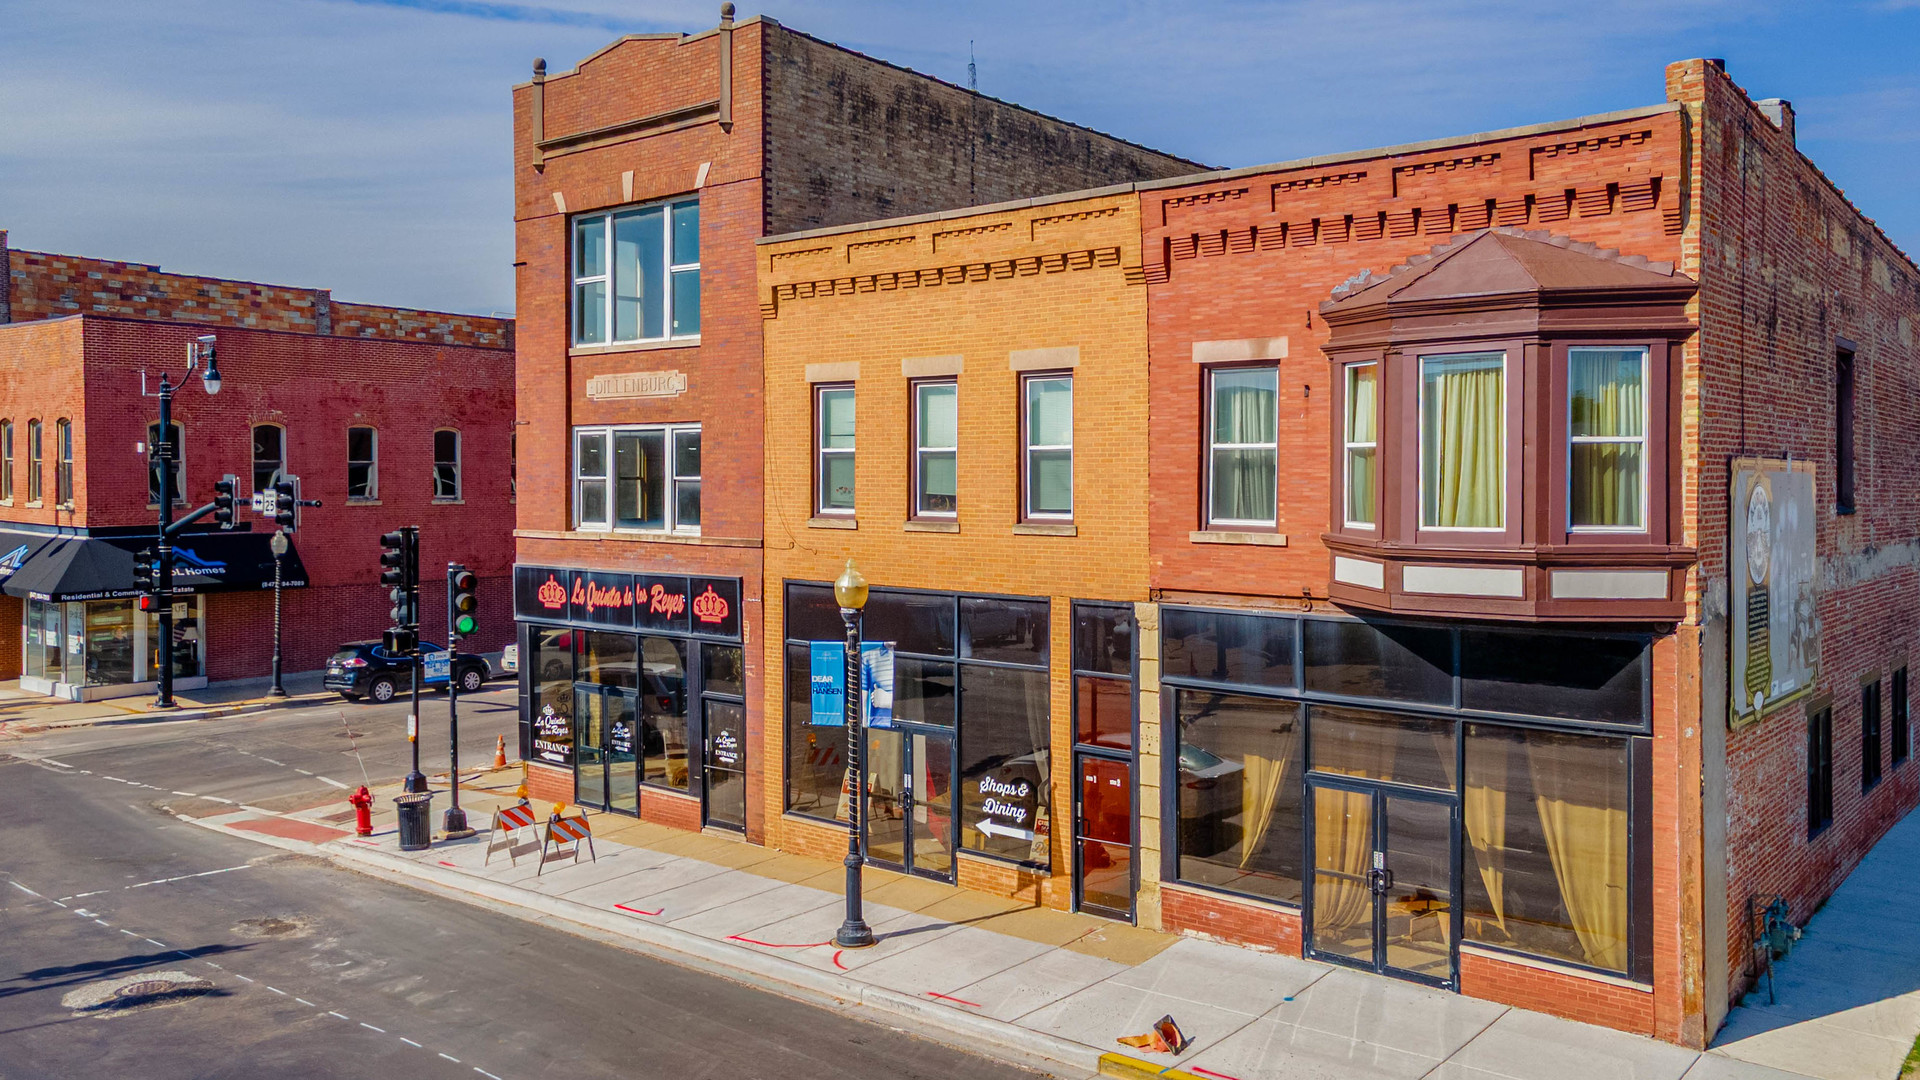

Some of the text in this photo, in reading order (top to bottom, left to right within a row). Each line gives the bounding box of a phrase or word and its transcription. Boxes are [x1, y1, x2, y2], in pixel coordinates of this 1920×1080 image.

[595, 376, 675, 394] DILLENBURG
[265, 500, 275, 511] 25
[185, 567, 226, 576] Homes
[61, 592, 103, 600] Residential
[571, 576, 685, 621] La Quinta de los Reyes
[812, 675, 834, 683] DEAR
[534, 715, 566, 729] La Quinta
[551, 725, 569, 737] Reyes
[534, 739, 570, 754] ENTRANCE
[715, 749, 738, 759] ENTRANCE
[979, 775, 1029, 797] Shops &
[982, 797, 1027, 823] Dining
